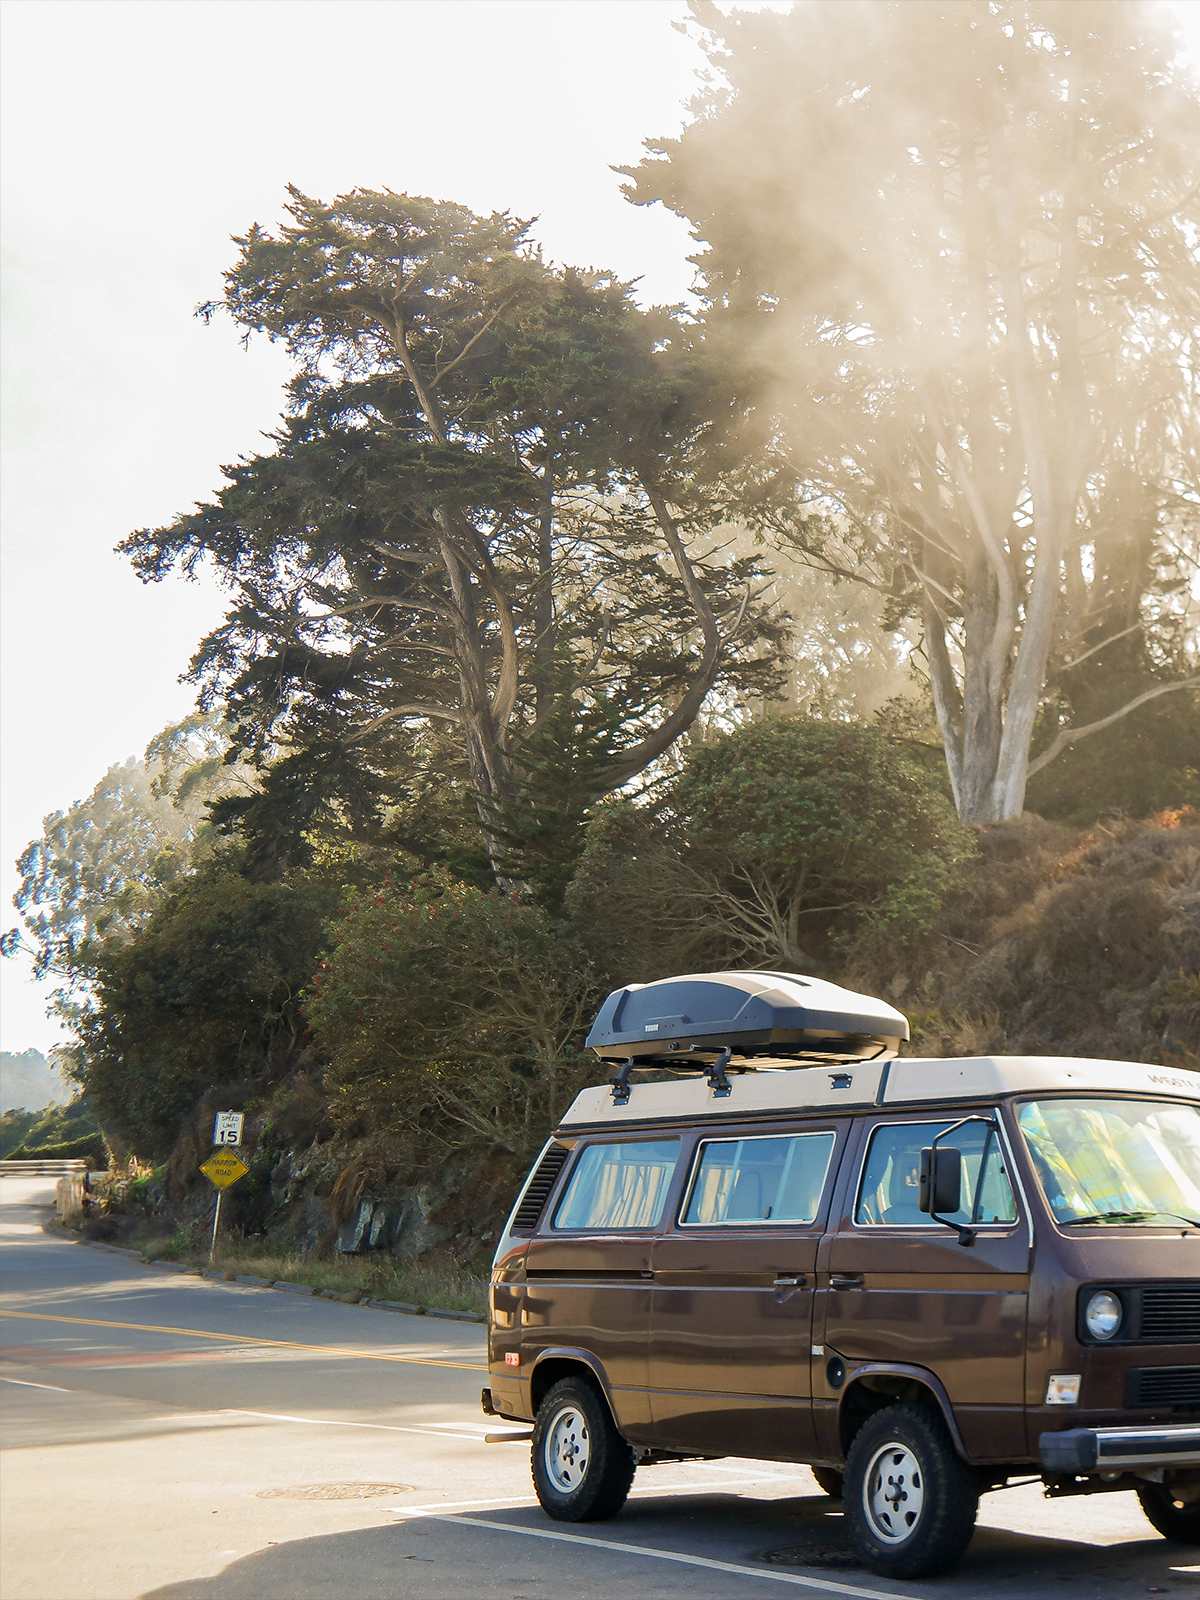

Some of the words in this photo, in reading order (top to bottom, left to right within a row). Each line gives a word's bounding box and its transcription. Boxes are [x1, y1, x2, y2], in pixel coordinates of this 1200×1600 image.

[219, 1130, 238, 1143] 15
[212, 1159, 238, 1167] NARROW
[215, 1168, 232, 1176] ROAD
